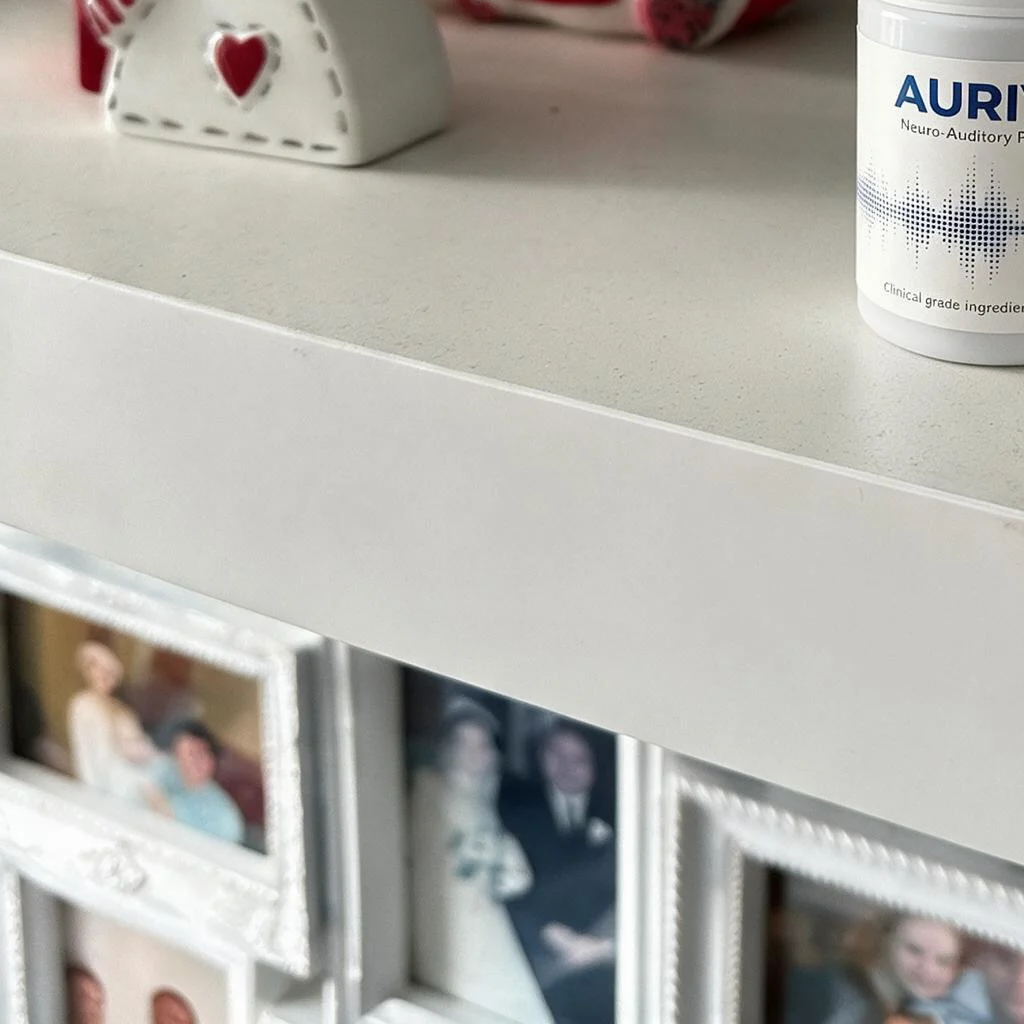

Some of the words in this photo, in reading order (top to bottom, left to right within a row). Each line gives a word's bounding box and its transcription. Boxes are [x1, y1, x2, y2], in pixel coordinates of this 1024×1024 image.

[900, 118, 1013, 146] Neuro-Auditory
[883, 281, 922, 303] Clinical
[925, 295, 961, 311] grade
